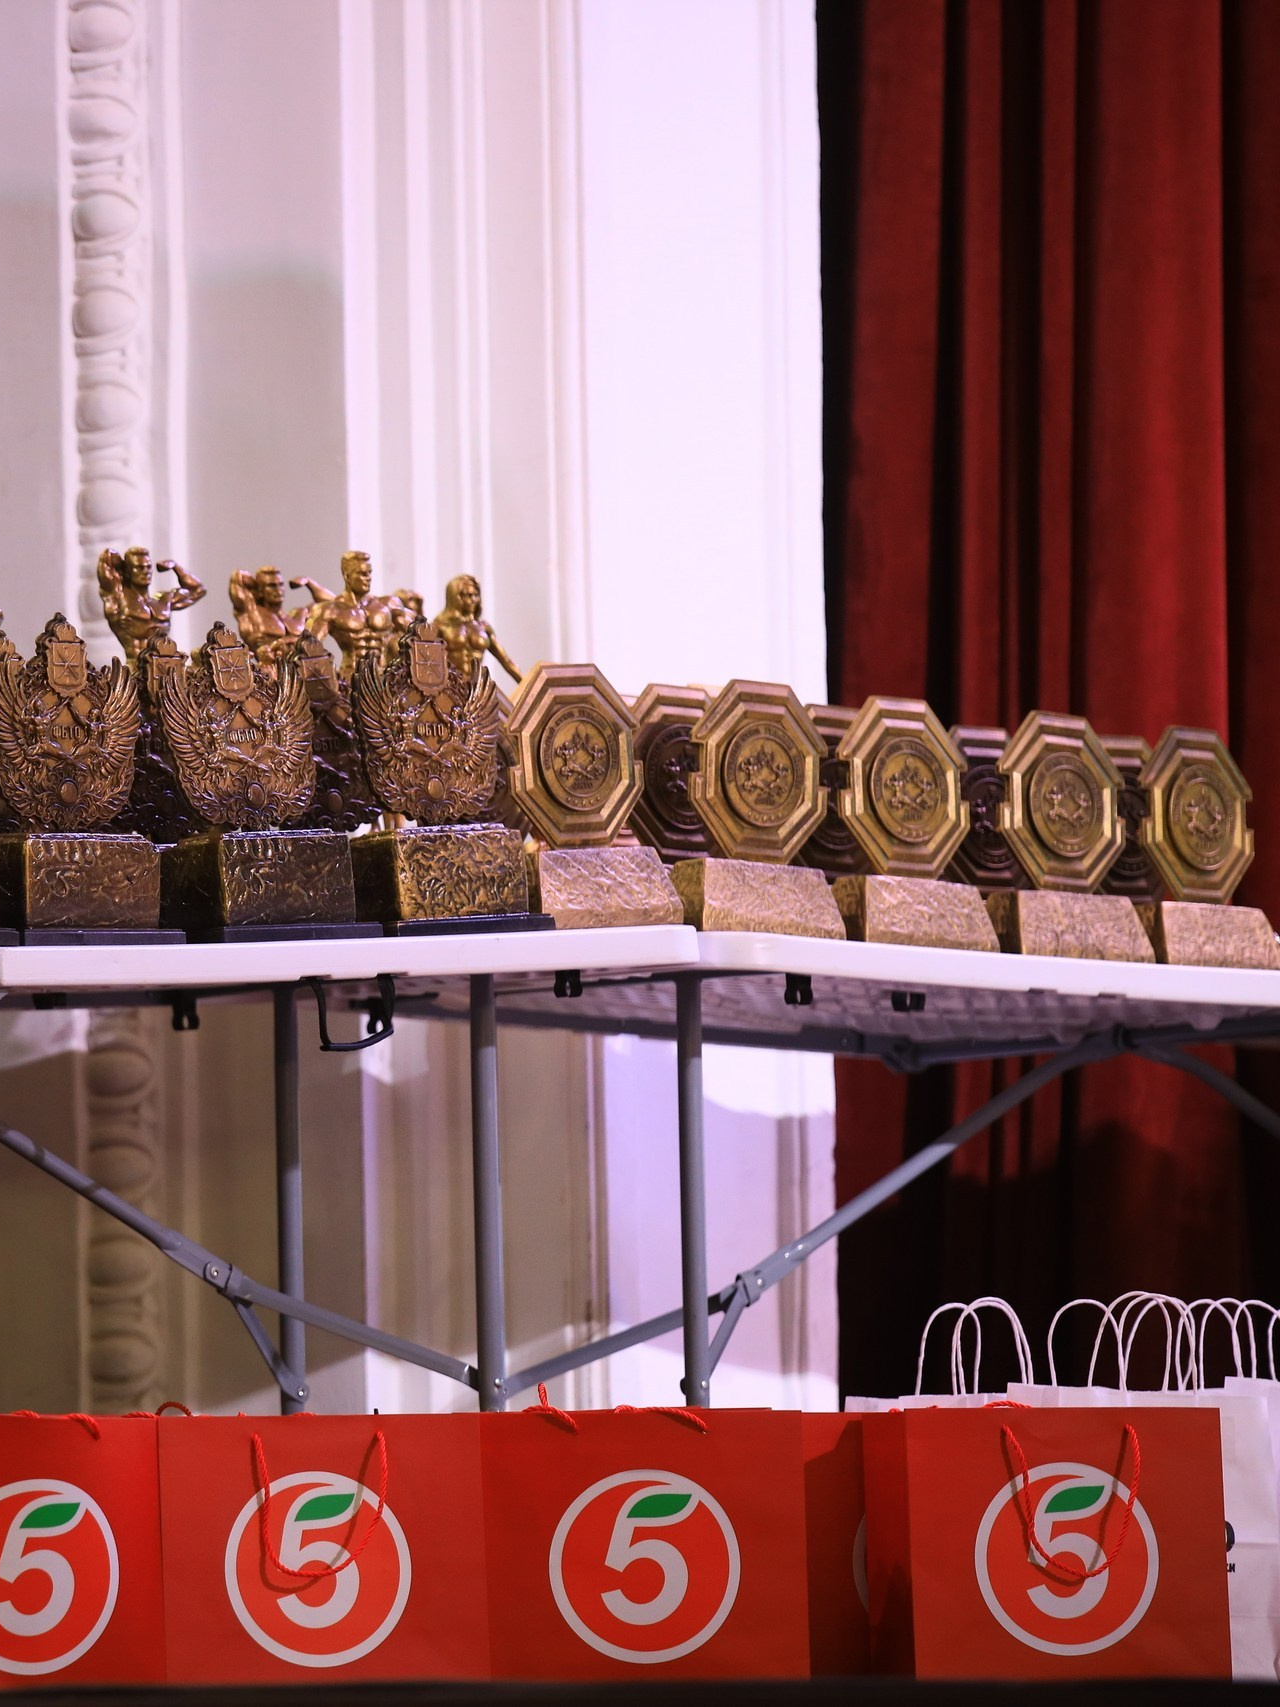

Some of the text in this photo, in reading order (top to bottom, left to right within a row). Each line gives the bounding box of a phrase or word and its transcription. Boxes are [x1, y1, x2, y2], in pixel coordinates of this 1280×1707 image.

[51, 723, 81, 739] ФБТО
[416, 721, 445, 737] ФБТО
[275, 1485, 362, 1629] 5
[600, 1483, 701, 1626] 5
[1026, 1478, 1113, 1619] 5
